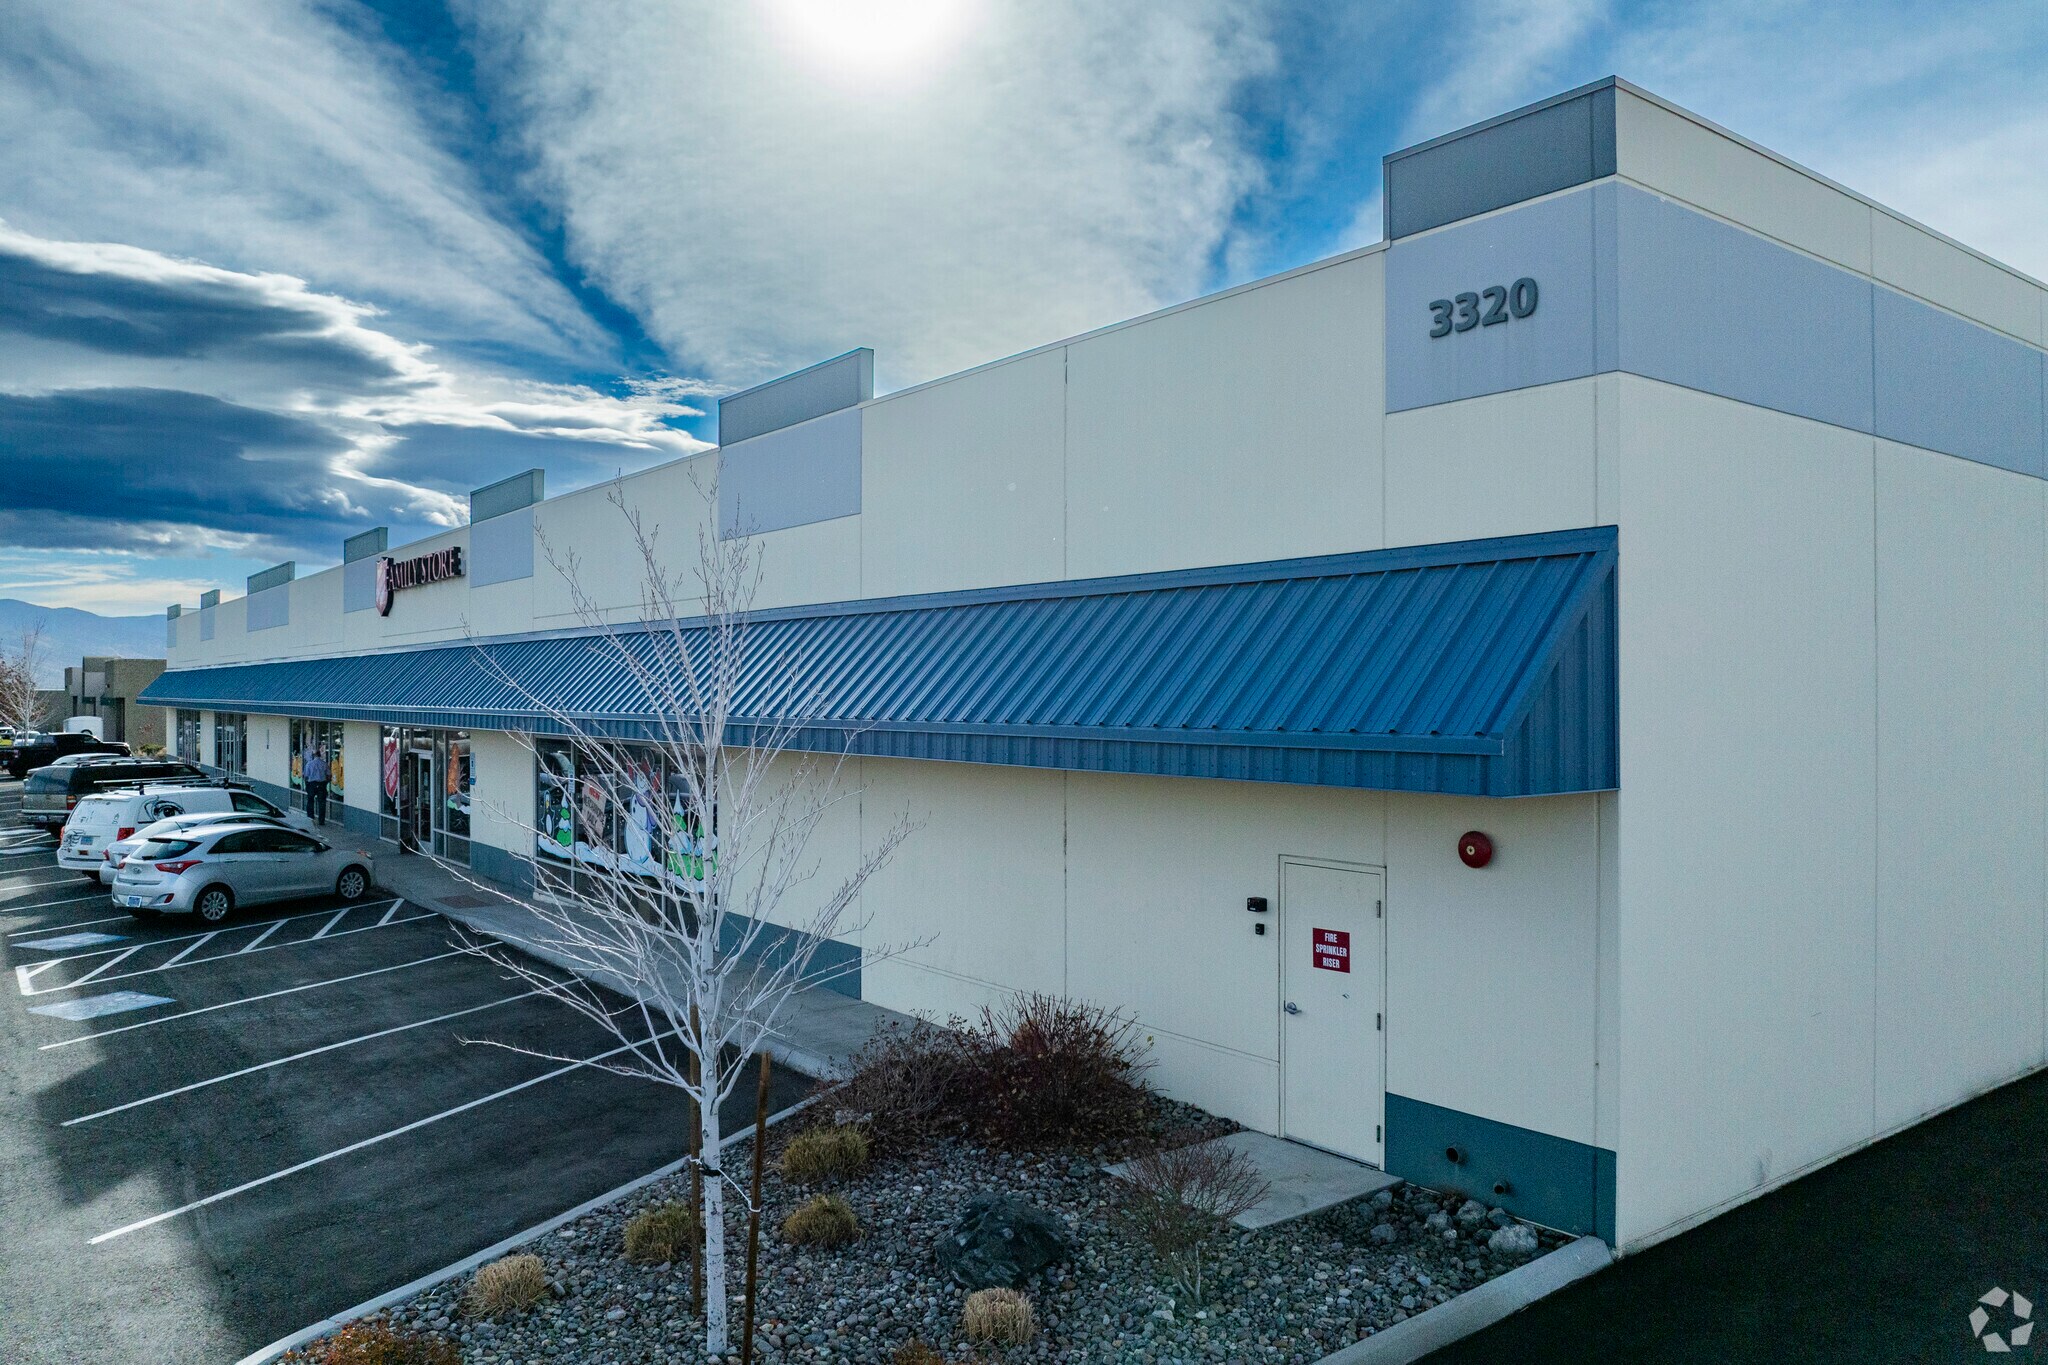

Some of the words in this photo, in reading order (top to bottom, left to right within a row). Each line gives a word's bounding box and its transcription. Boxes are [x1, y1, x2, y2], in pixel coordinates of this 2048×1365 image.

[1429, 277, 1539, 338] 3320
[386, 557, 421, 592] AMILY
[421, 546, 461, 585] STORE
[1324, 932, 1338, 943] FIRE
[1315, 943, 1347, 957] SPRINKLER
[1322, 956, 1340, 968] RISER
